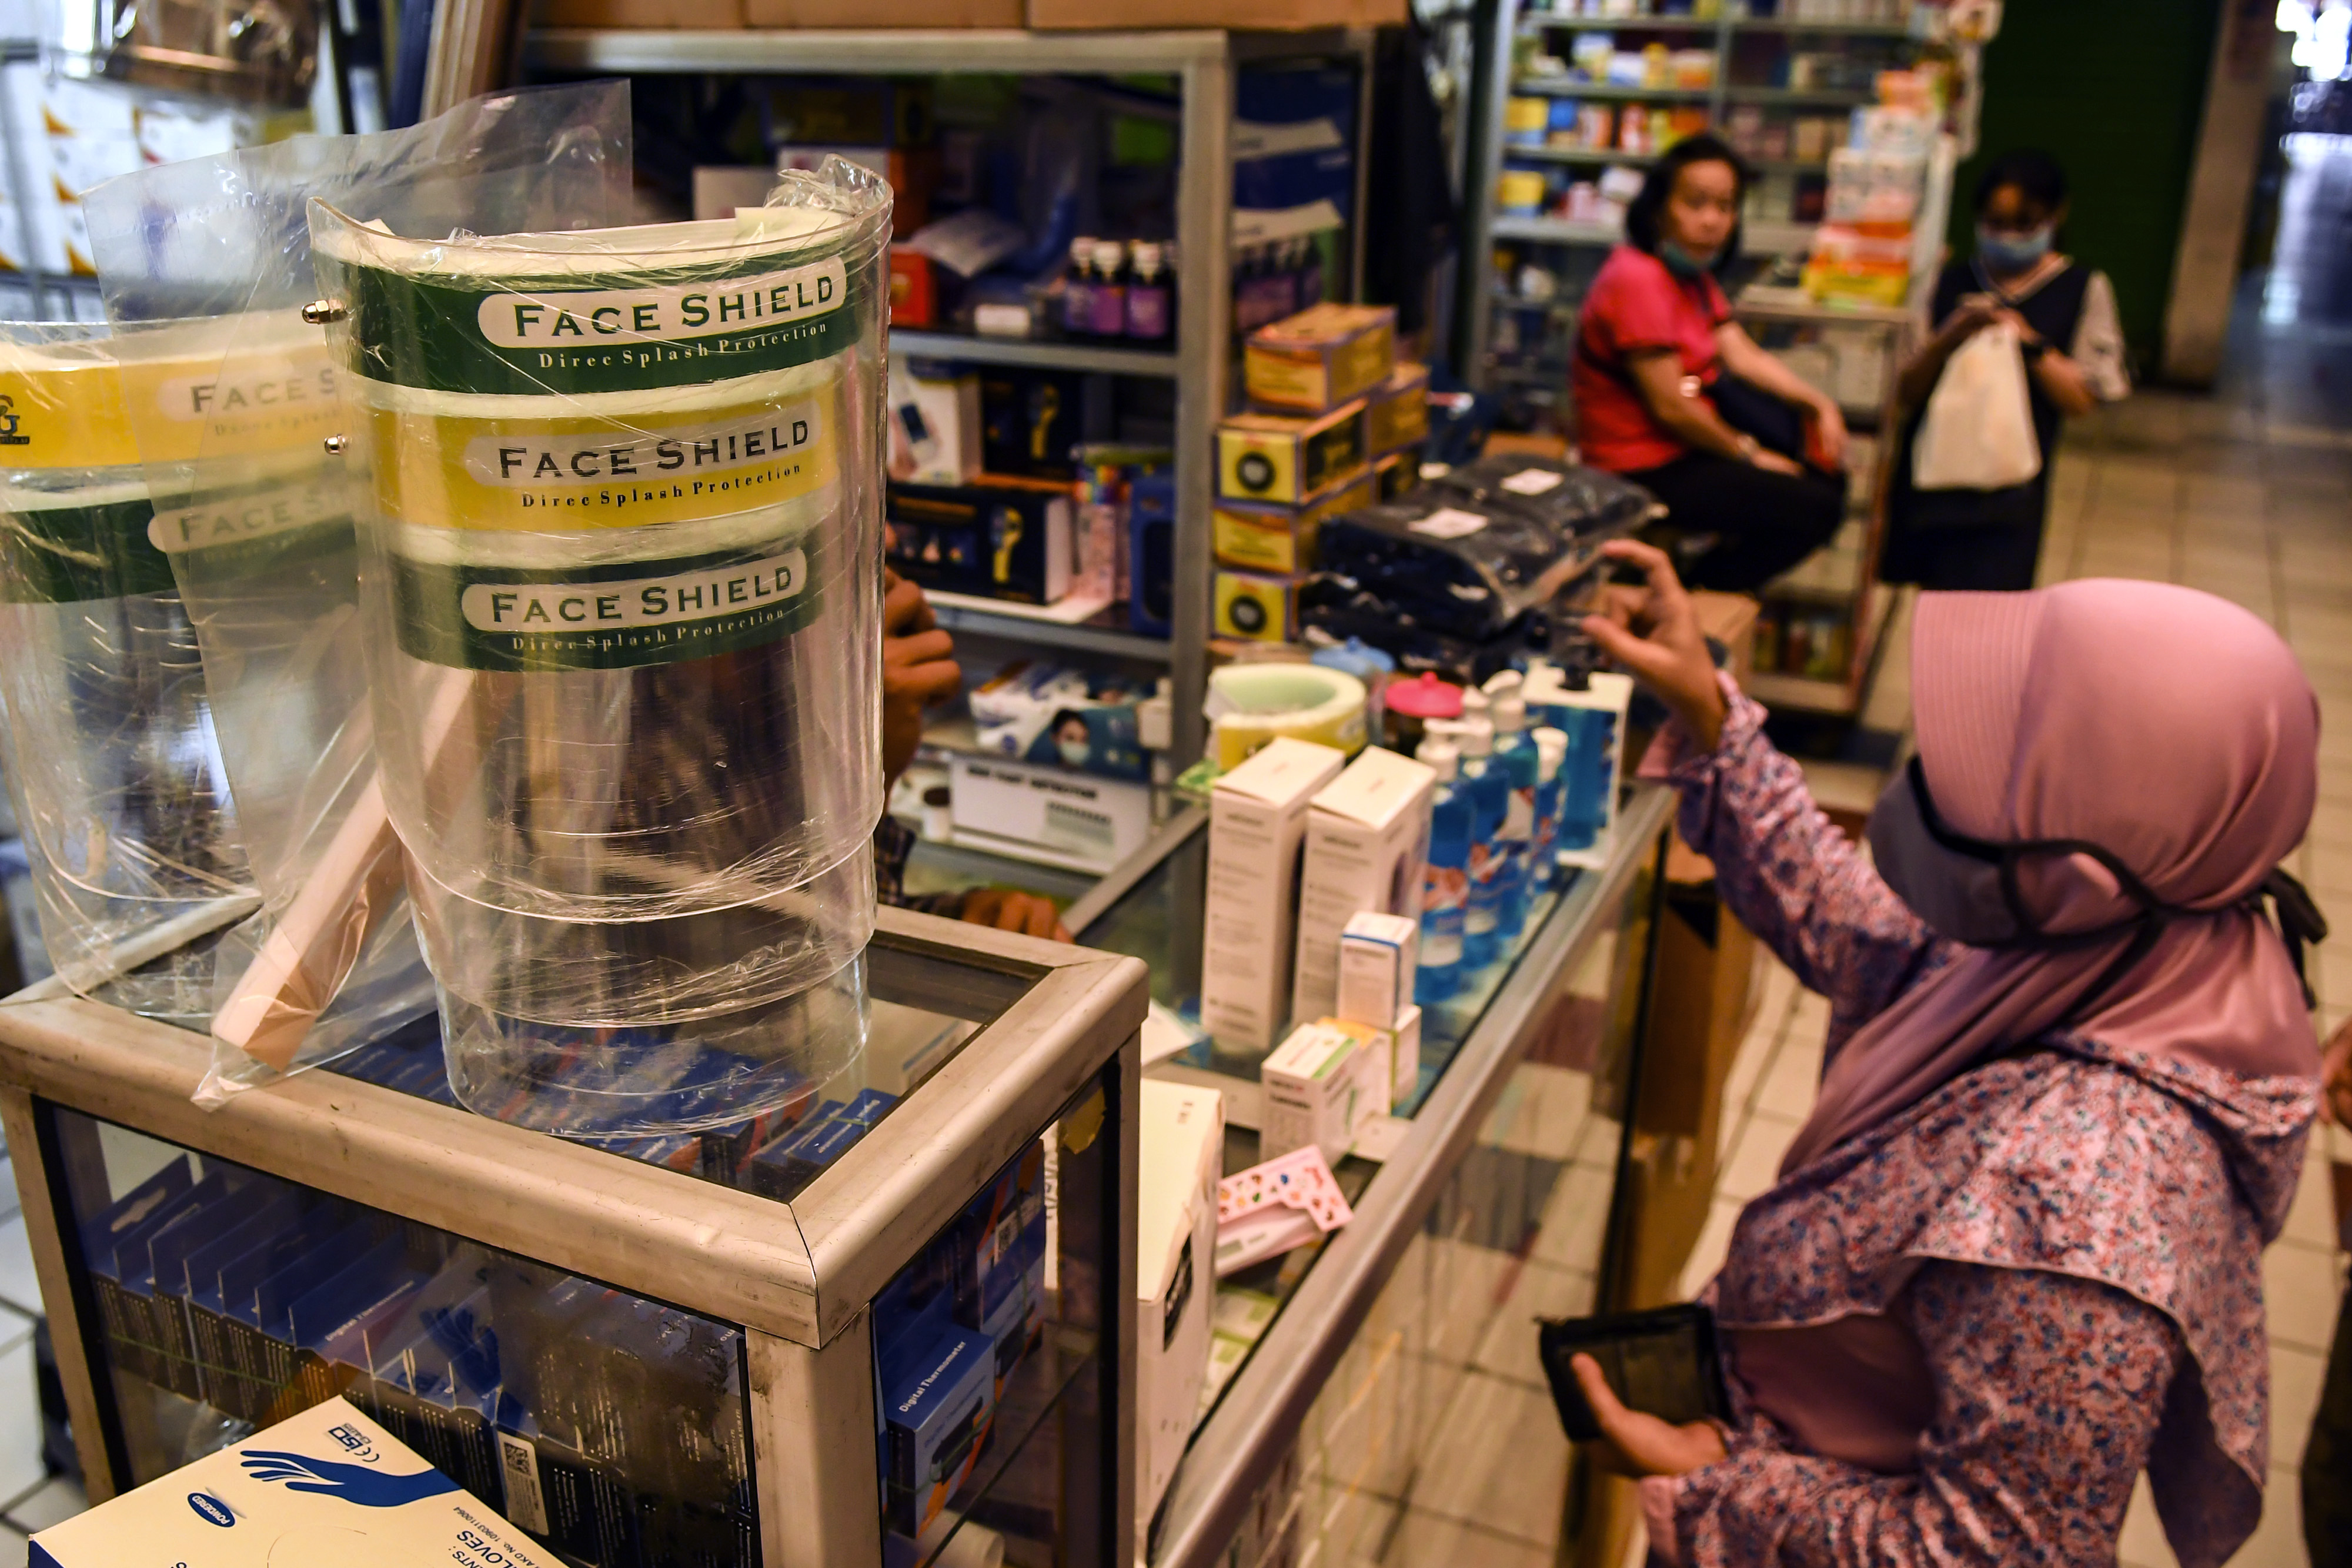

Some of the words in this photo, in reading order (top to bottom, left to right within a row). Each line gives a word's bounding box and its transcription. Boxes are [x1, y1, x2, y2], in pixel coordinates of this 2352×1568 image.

[513, 303, 661, 337] FACE
[680, 275, 833, 326] SHIELD
[623, 343, 709, 368] Splash
[718, 323, 827, 353] Protection
[189, 378, 307, 413] FACE
[499, 447, 637, 479] FACE
[656, 420, 809, 469] SHIELD
[600, 485, 683, 507] Splash
[693, 463, 801, 495] Protection
[491, 592, 622, 623] FACE
[641, 565, 792, 615] SHIELD
[587, 629, 667, 652] Splash
[677, 608, 784, 640] Protection
[898, 1386, 926, 1412] Digital
[920, 1340, 966, 1387] Thermometer
[192, 1495, 230, 1525] POWDERED
[456, 1530, 519, 1568] LOVES
[514, 1553, 535, 1566] AKD
